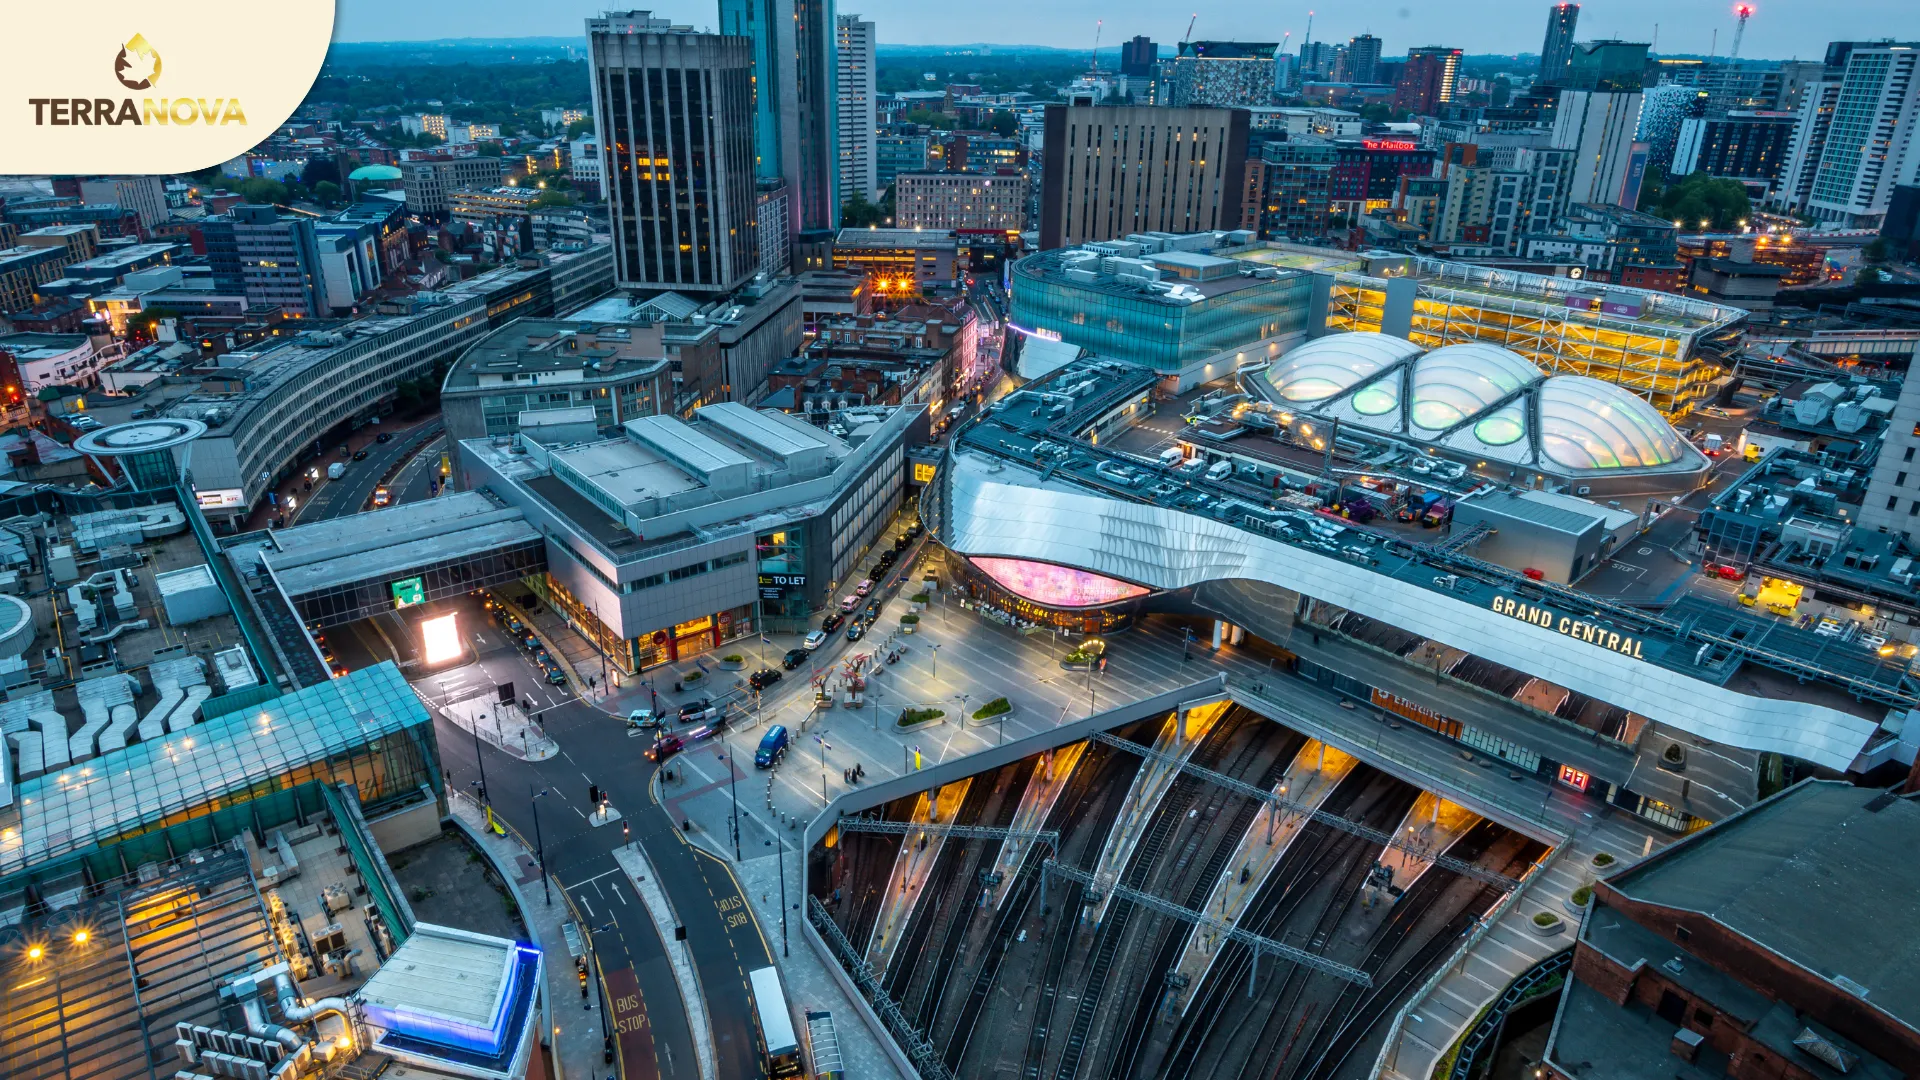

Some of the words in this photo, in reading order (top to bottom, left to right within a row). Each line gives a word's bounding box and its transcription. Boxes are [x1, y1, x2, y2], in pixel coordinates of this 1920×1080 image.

[1362, 139, 1378, 149] The
[1380, 140, 1414, 150] Mailbox
[1611, 563, 1636, 572] STOP
[773, 576, 787, 585] TO
[788, 576, 806, 585] LET
[1492, 595, 1553, 629] GRAND
[1558, 617, 1645, 660] CENTRAL
[719, 895, 742, 912] STOP
[727, 912, 748, 928] BUS
[616, 994, 639, 1013] BUS
[618, 1014, 646, 1034] STOP
